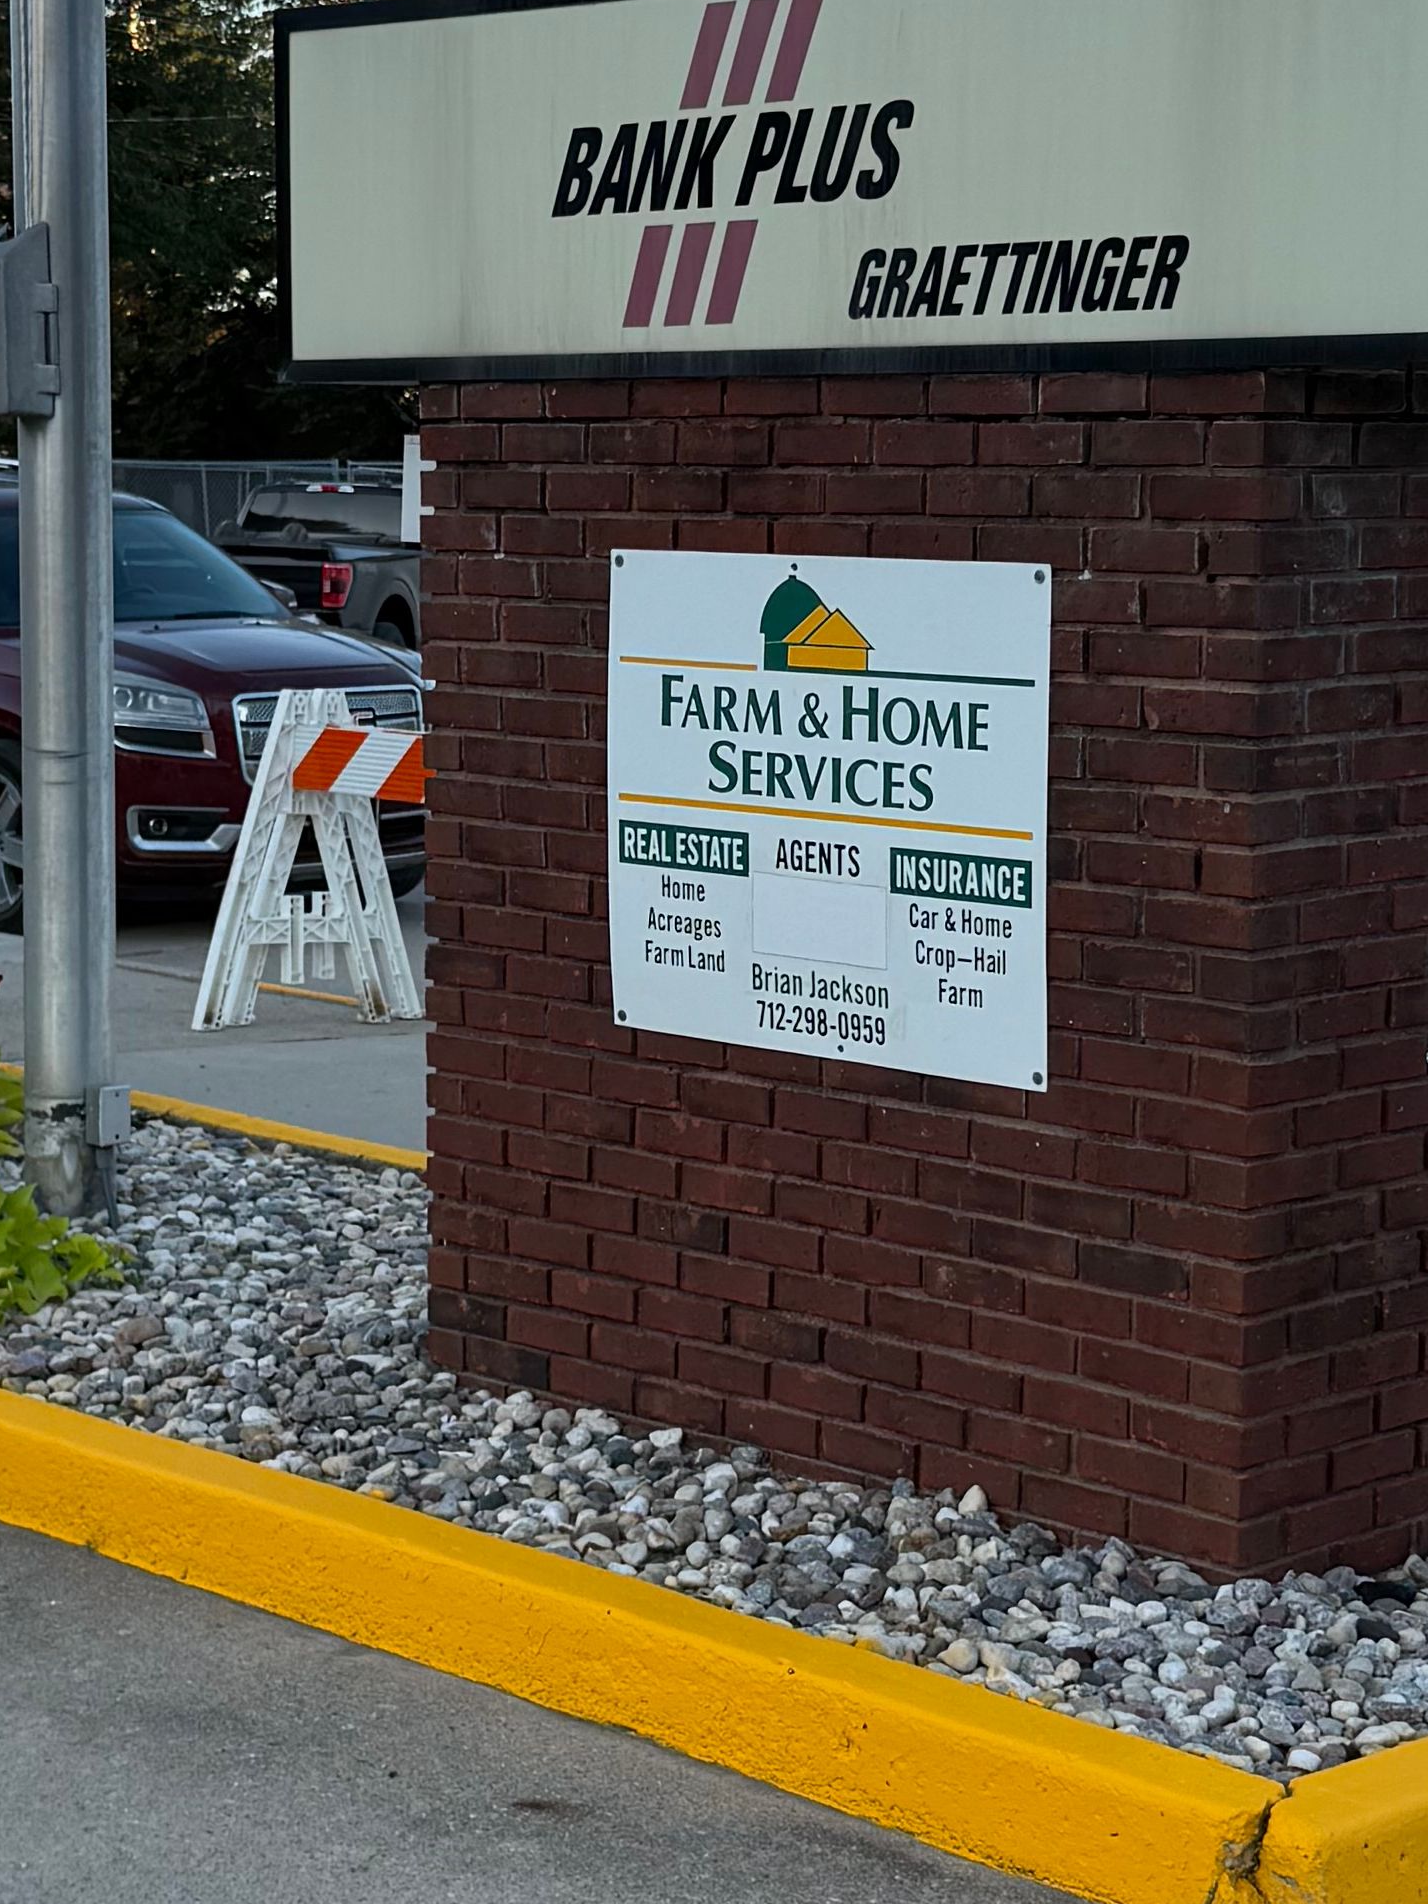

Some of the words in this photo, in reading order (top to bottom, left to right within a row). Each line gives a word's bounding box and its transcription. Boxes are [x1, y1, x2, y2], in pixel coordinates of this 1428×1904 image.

[551, 114, 737, 218] BANK
[734, 99, 915, 206] PLUS
[848, 235, 1190, 320] GRAETTINGER
[660, 674, 782, 736] FARM
[798, 692, 829, 739] &
[842, 685, 989, 752] HOME
[708, 740, 934, 812] SERVICES
[624, 826, 672, 863] REAL
[675, 832, 744, 871] ESTATE
[775, 838, 861, 877] AGENTS
[661, 874, 706, 902] Home
[895, 854, 1026, 902] INSURANCE
[647, 906, 722, 941] Acreages
[909, 902, 939, 930] Car
[944, 907, 957, 932] &
[961, 908, 1012, 939] Home
[645, 939, 684, 968] Farm
[688, 945, 725, 973] Land
[752, 962, 803, 997] Brian
[809, 970, 889, 1009] Jackson
[938, 978, 983, 1009] Farm
[755, 1000, 886, 1046] 712-298-0959
